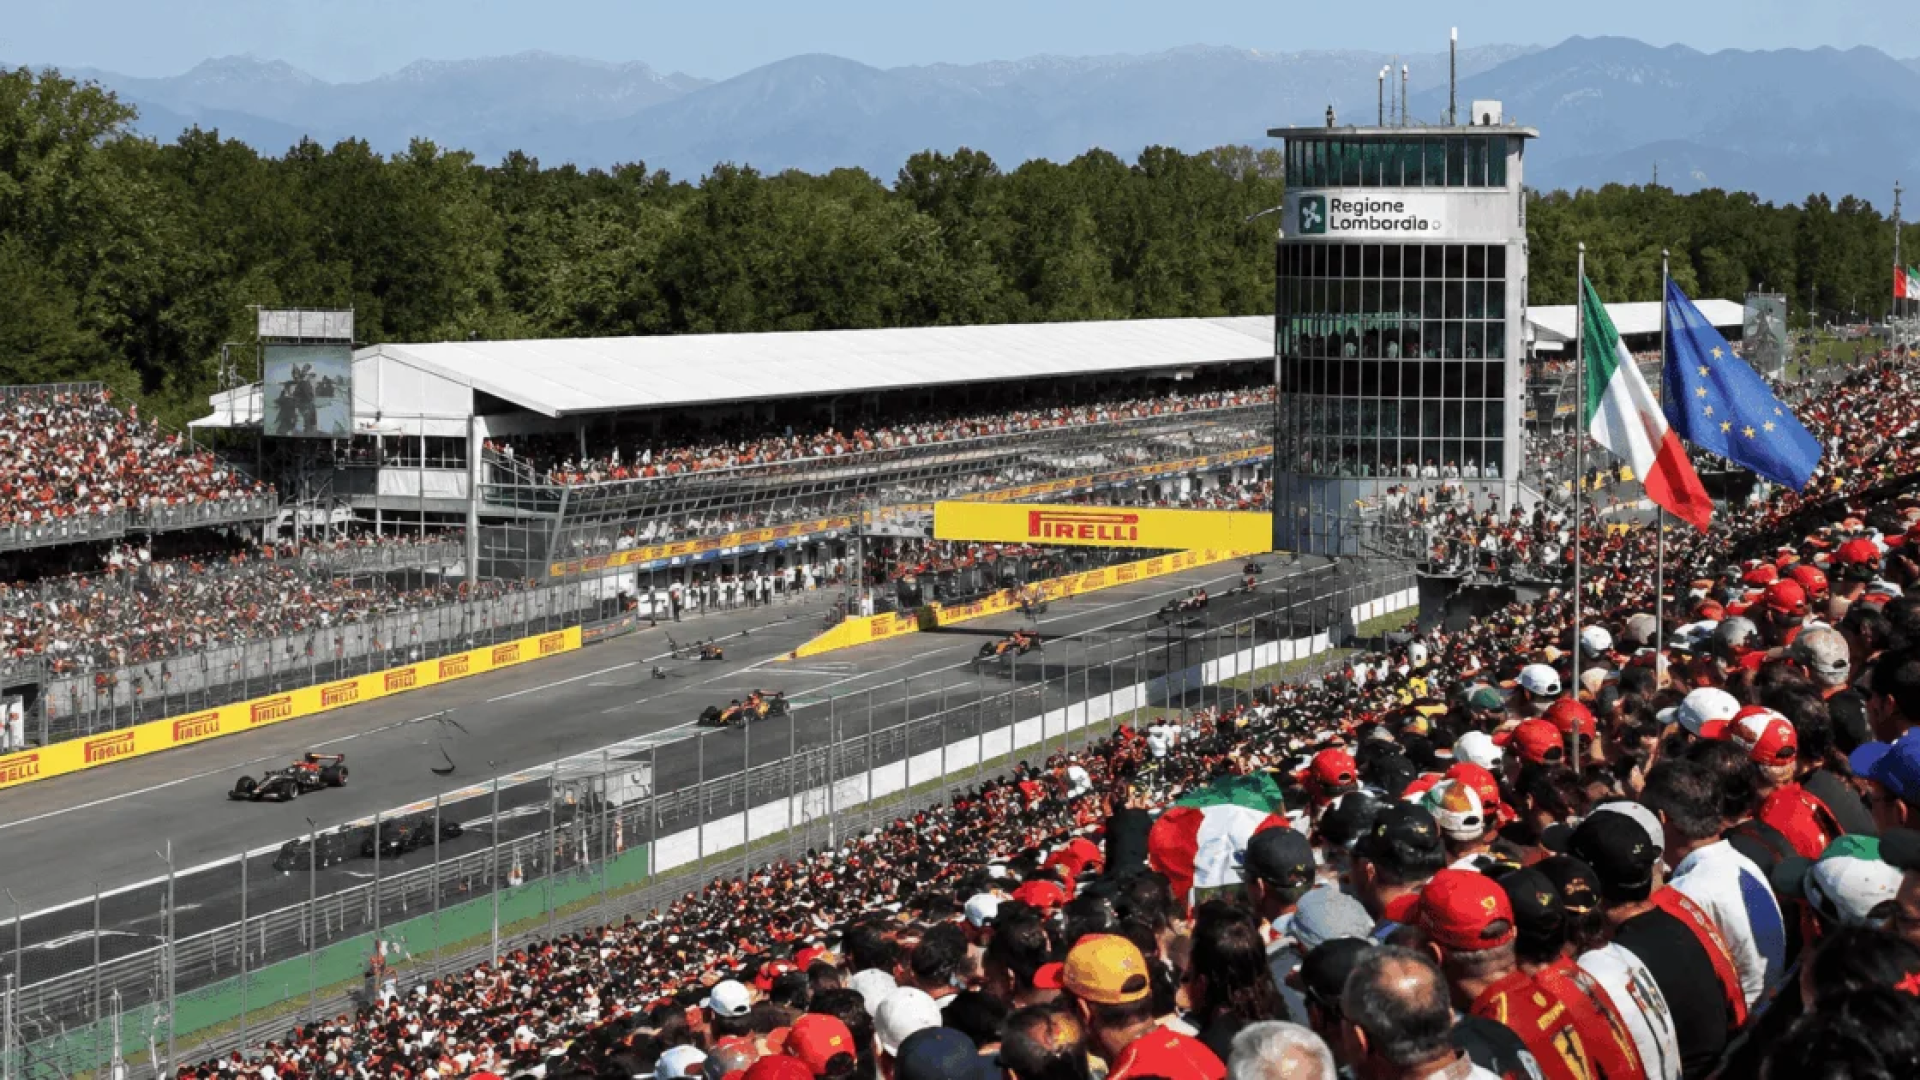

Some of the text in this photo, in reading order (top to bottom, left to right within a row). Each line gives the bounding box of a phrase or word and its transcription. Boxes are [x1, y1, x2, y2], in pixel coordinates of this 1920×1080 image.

[1331, 197, 1404, 216] Regione
[1028, 510, 1139, 541] PIRELLI
[172, 712, 219, 742] PIRELLI
[84, 731, 135, 764] PIRELLI
